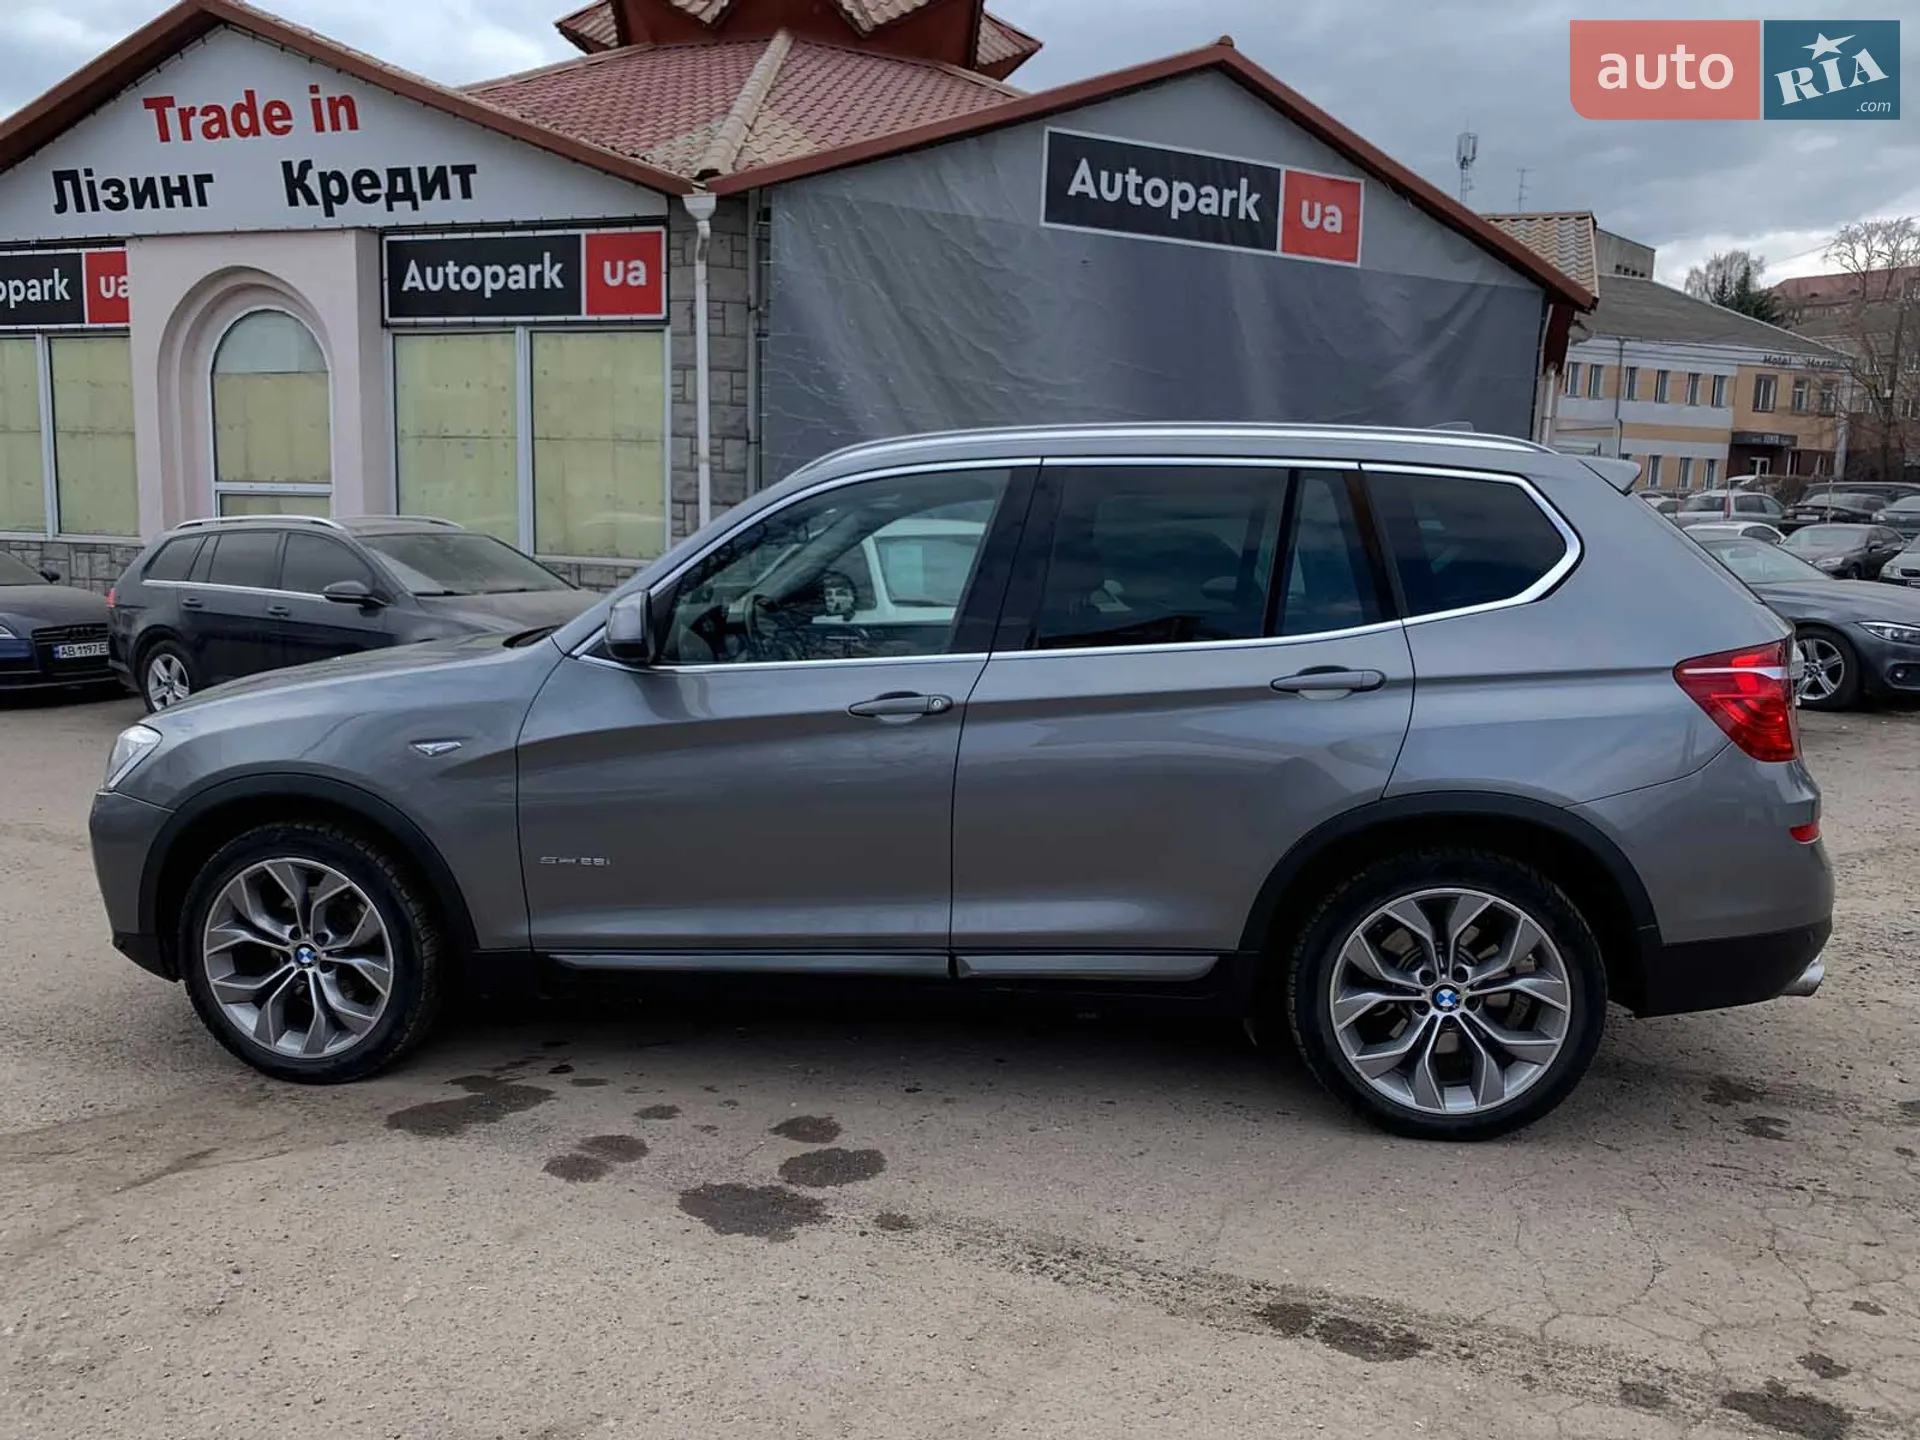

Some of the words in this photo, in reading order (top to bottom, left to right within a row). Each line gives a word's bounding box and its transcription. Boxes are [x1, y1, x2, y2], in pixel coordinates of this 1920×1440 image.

[143, 89, 293, 143] Trade
[308, 85, 359, 132] in
[52, 168, 214, 214] Лізинг
[280, 158, 477, 218] Кредит
[1067, 157, 1260, 222] Autopark
[1300, 199, 1343, 234] ua
[401, 251, 564, 298] Autopark
[603, 259, 647, 287] ua
